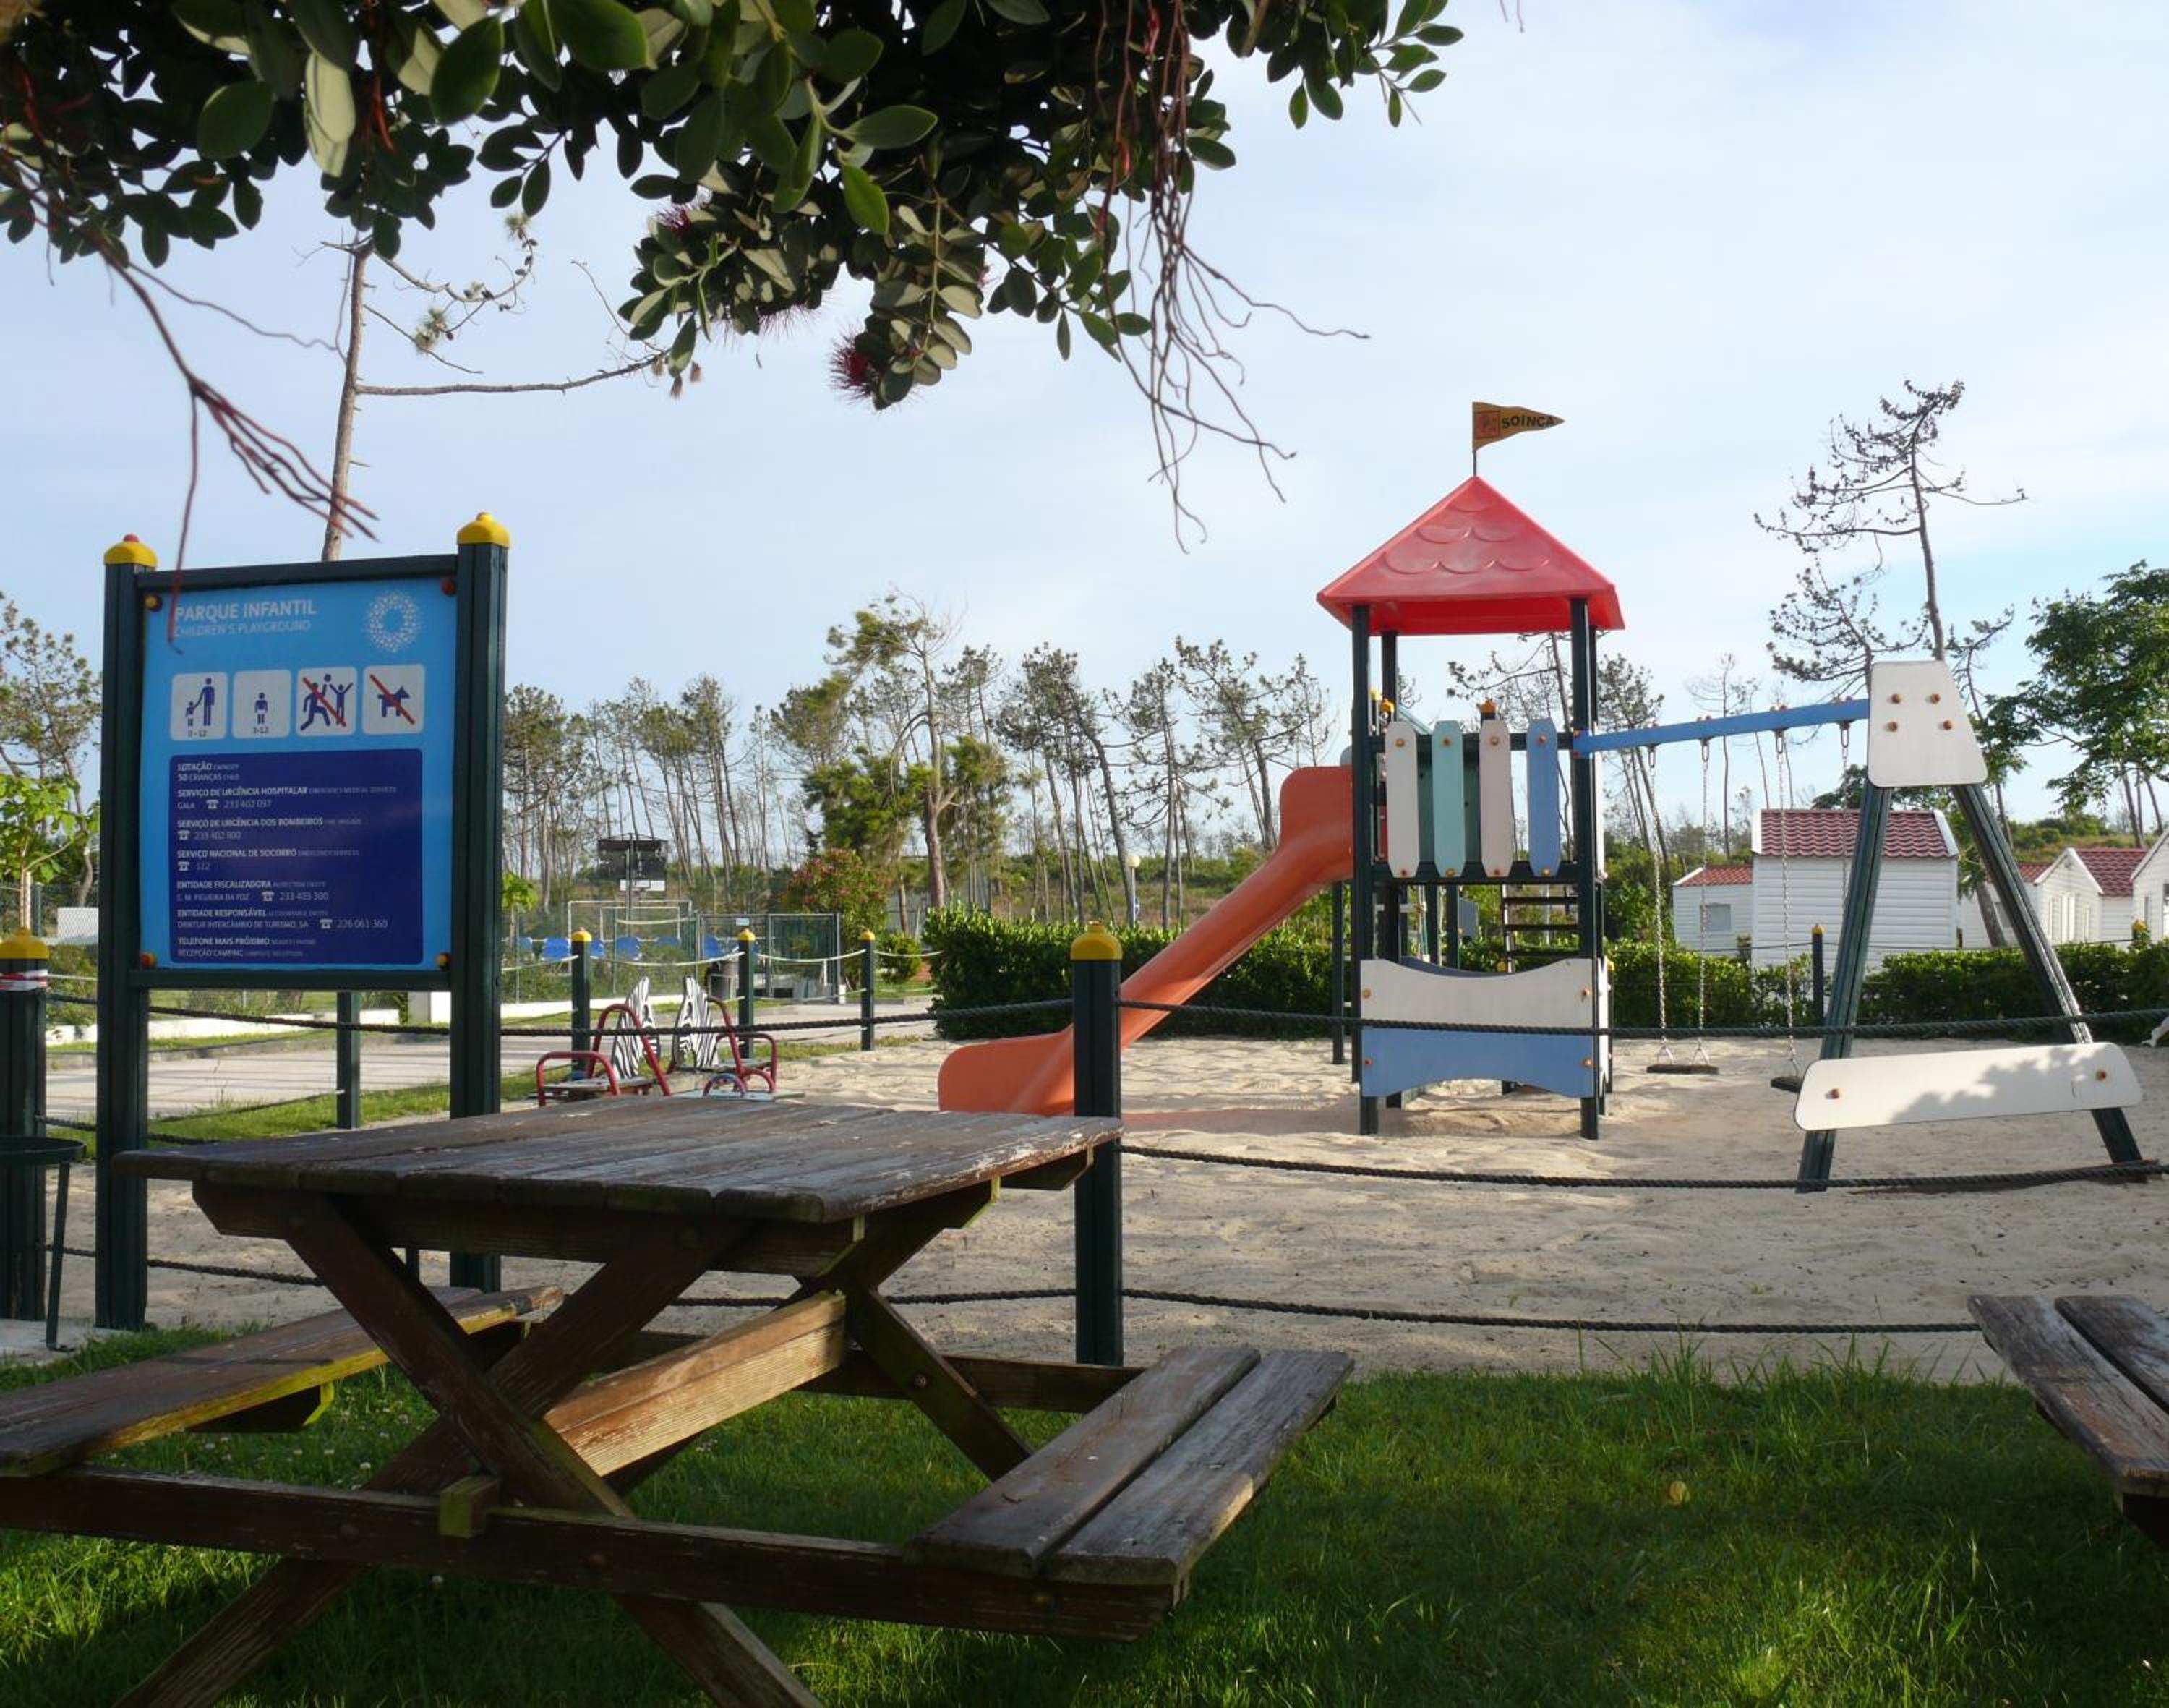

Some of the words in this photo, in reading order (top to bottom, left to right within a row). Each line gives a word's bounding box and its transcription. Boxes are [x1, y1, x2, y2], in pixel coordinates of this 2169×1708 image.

[1502, 415, 1554, 429] SOINCA
[175, 602, 239, 623] PARQUE
[243, 599, 317, 618] INFANTIL
[178, 761, 213, 772] LOTAÇÃO
[178, 789, 208, 798] SERVIÇO
[222, 786, 260, 796] URGÊNCIA
[261, 786, 308, 795] HOSPITALAR
[177, 819, 208, 829] SERVIÇO
[177, 850, 208, 860] SERVIÇO
[260, 848, 297, 857] SOCORRO
[177, 880, 213, 889] ENTIDADE
[177, 909, 214, 918] ENTIDADE
[215, 907, 266, 917] RESPONSÁVEL
[179, 937, 213, 946] TELEFONE
[235, 935, 270, 945] PRÓXIMO
